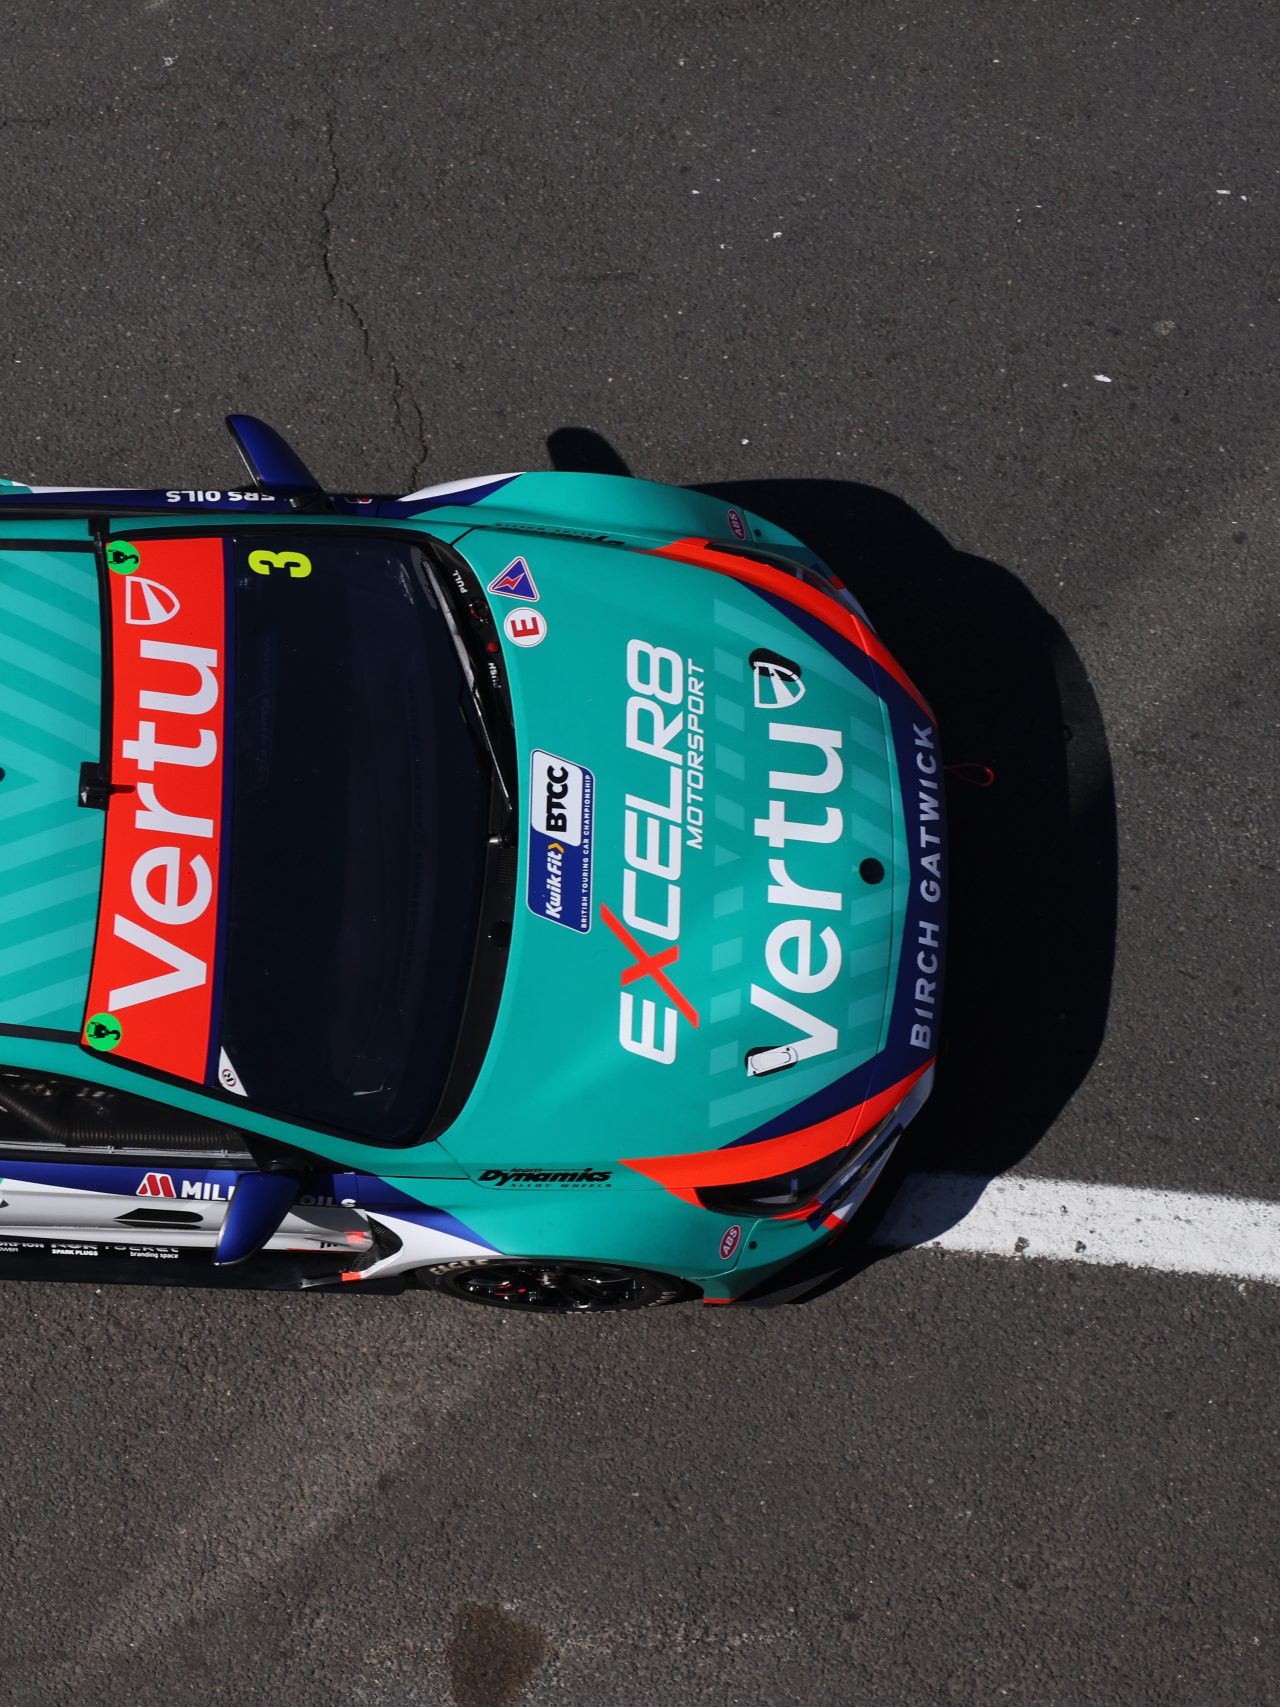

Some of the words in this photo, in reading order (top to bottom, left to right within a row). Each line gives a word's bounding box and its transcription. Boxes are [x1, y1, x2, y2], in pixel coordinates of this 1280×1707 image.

[166, 490, 222, 503] OILS
[248, 549, 312, 579] 3
[452, 569, 468, 594] PULL
[511, 616, 540, 638] E
[685, 658, 705, 850] MOTORSPORT
[546, 764, 569, 833] BTCC
[584, 775, 592, 836] CHAMPIONSHIP
[913, 722, 942, 903] GATWICK
[107, 639, 219, 1012] Vertu
[582, 839, 590, 855] CAR
[600, 638, 700, 1065] EXCELR8
[747, 722, 844, 1077] Vertu
[910, 922, 941, 1051] BIRCH
[477, 1168, 613, 1187] Dynamics
[75, 1249, 98, 1257] PLUGS
[130, 1251, 159, 1259] branding
[723, 1228, 737, 1255] ABS
